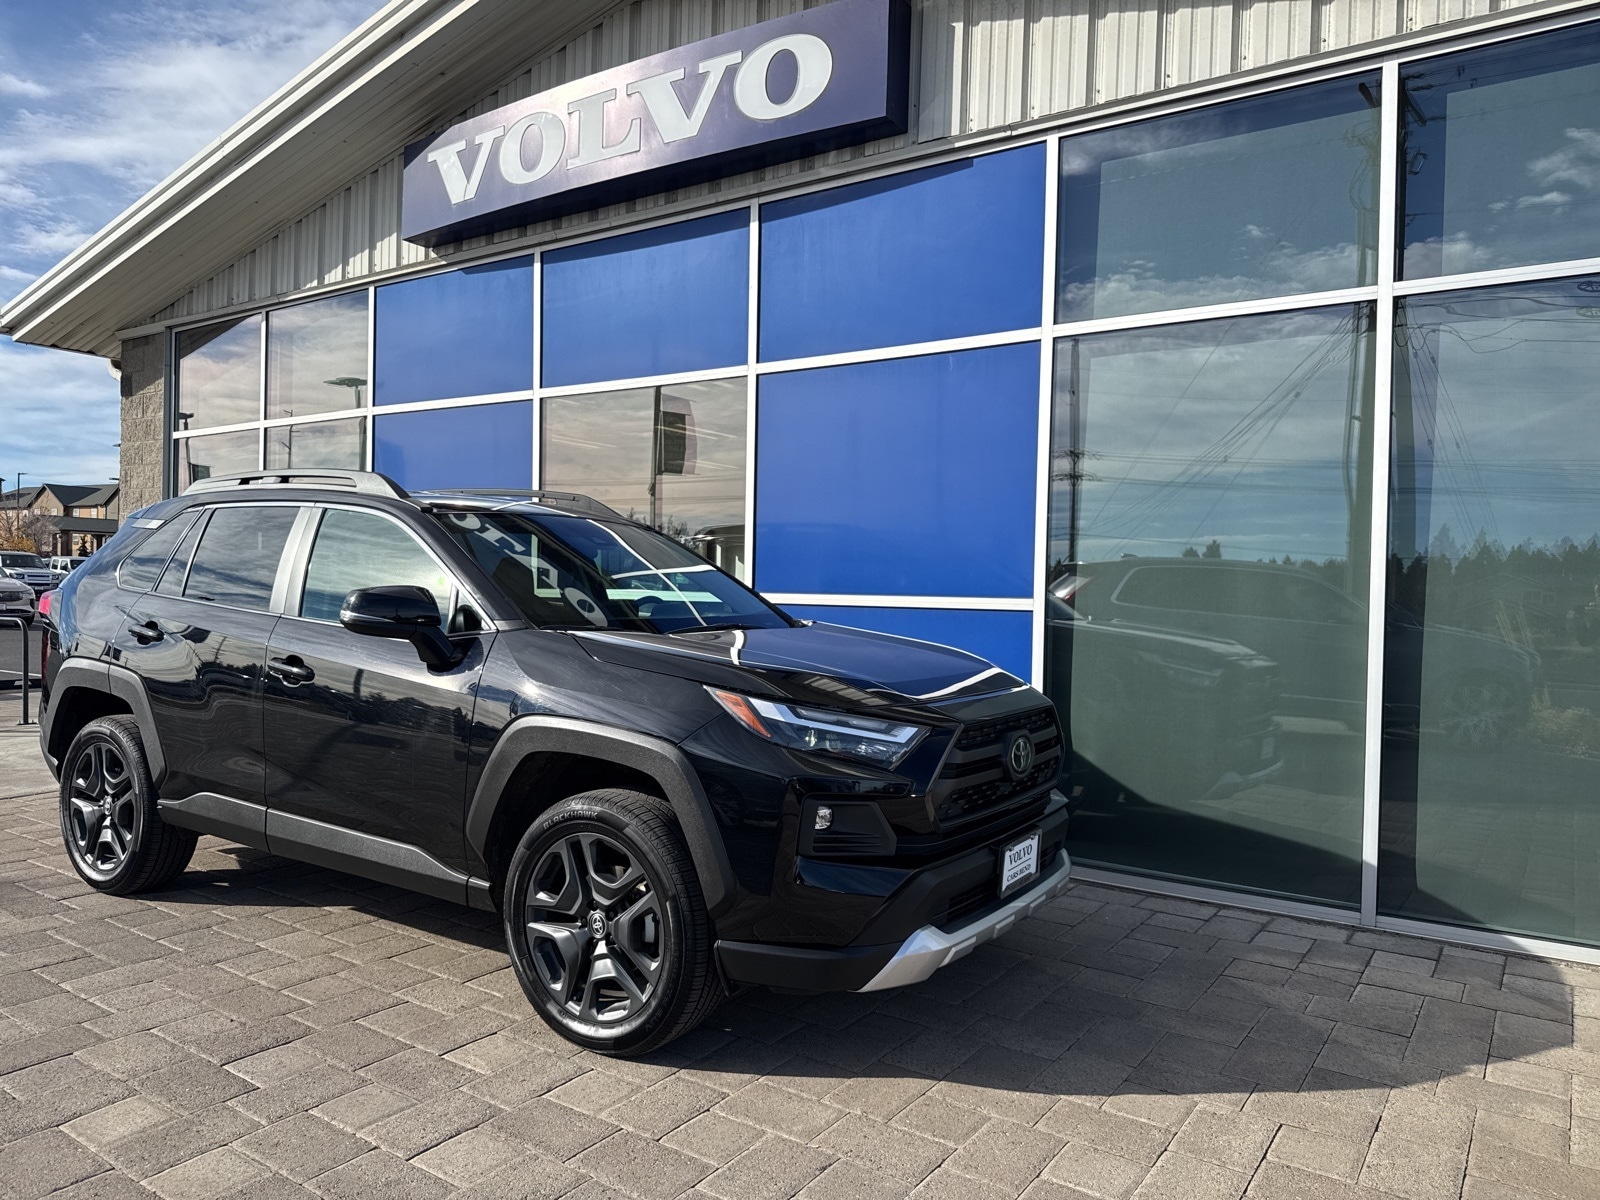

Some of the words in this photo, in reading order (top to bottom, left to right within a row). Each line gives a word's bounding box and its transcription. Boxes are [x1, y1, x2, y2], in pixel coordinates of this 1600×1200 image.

[427, 32, 834, 206] VOLVO
[543, 810, 598, 830] BLACKHAWK
[1009, 844, 1032, 865] VOLVO
[1007, 871, 1019, 882] CARS
[1019, 864, 1031, 875] BEND
